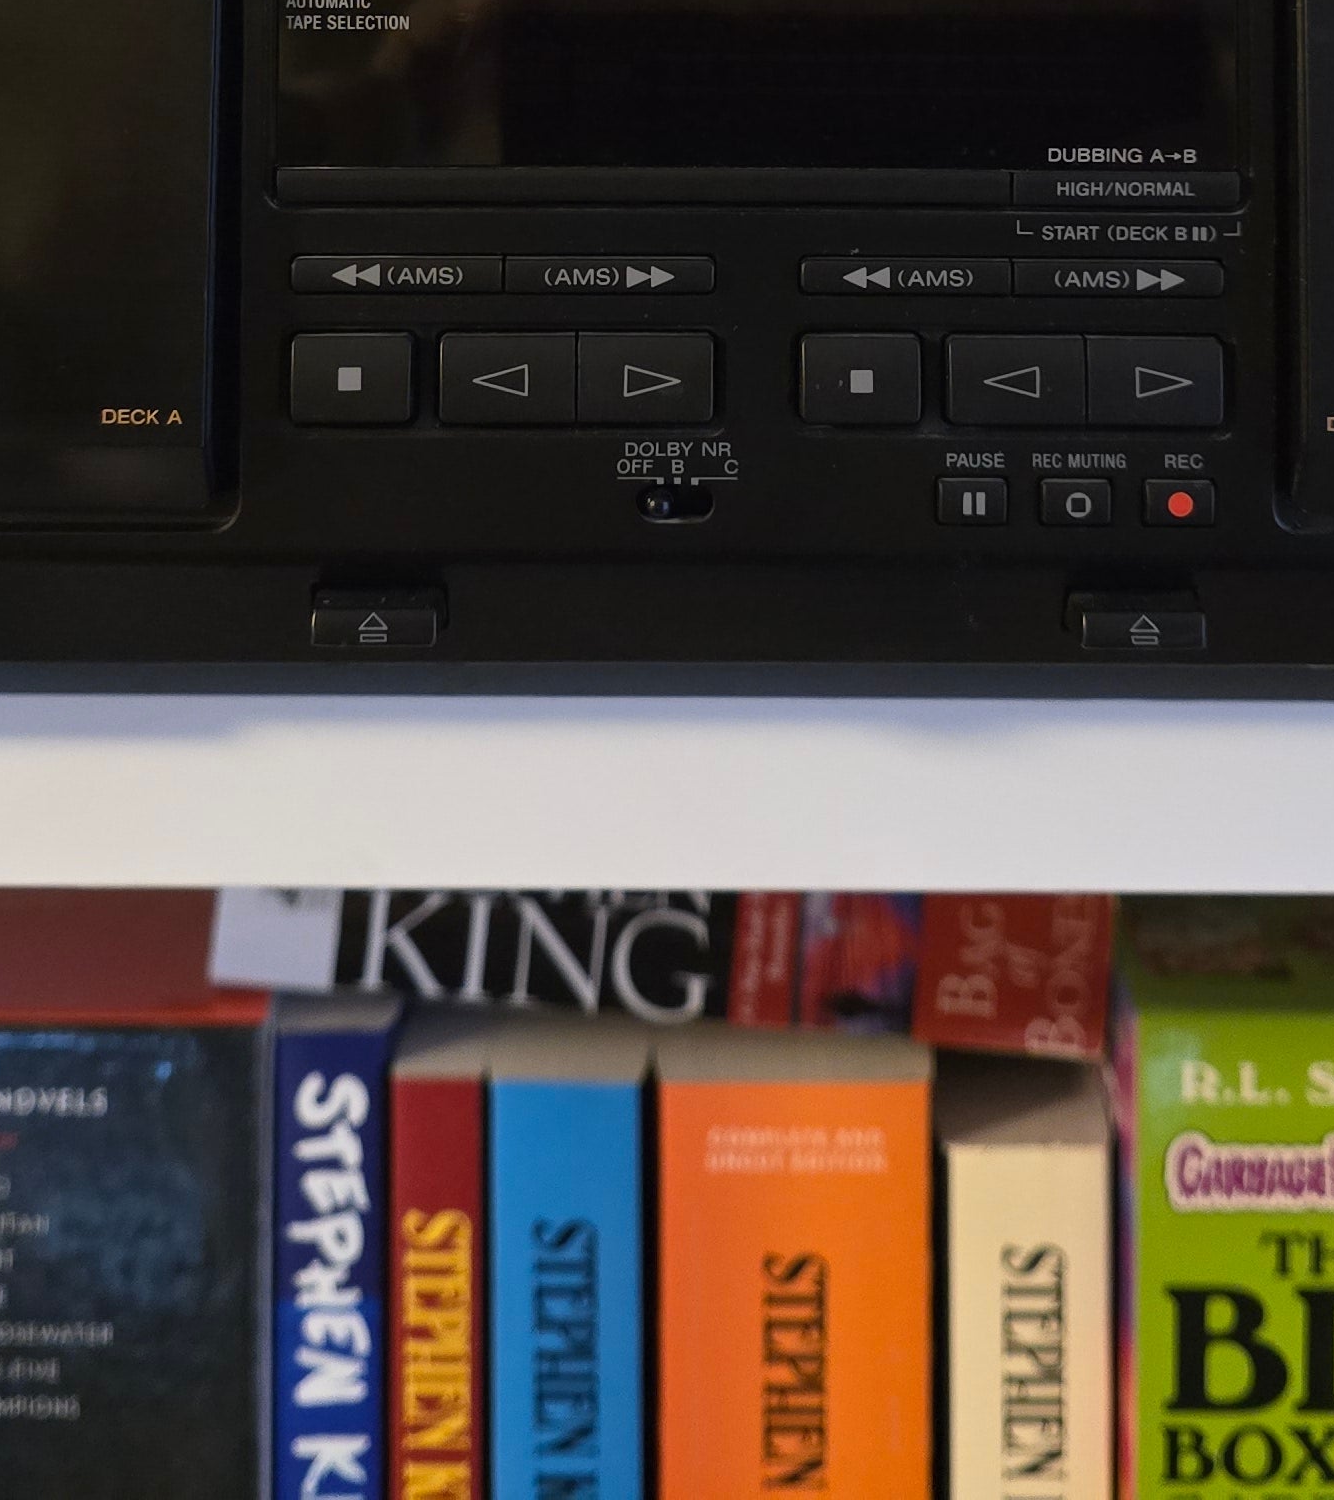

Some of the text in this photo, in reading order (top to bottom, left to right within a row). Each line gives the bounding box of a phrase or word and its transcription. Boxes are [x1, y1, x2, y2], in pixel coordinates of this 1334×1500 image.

[286, 16, 410, 31] TAPE SELECTION
[1047, 148, 1143, 164] DUBBING
[1056, 181, 1196, 198] HIGH/NORMAL
[1041, 226, 1100, 242] START
[386, 265, 464, 288] (AMS)
[543, 265, 621, 288] (AMS)
[896, 268, 974, 289] (AMS)
[1053, 269, 1131, 290] (AMS)
[101, 408, 183, 425] DECK A
[624, 441, 732, 457] DOLBY NR
[616, 459, 654, 474] OFF
[670, 460, 685, 474] B
[723, 460, 740, 474] C
[945, 452, 1006, 469] PAUSE
[1032, 453, 1127, 469] REC MUTING
[1164, 453, 1204, 470] REC
[360, 890, 710, 1024] KING
[1180, 1060, 1291, 1104] R.L.
[285, 1071, 370, 1407] STEPHEN
[401, 1208, 473, 1451] STEPHEN
[531, 1216, 601, 1457] STEPHEN
[1001, 1241, 1066, 1483] STEPHEN
[761, 1250, 830, 1492] STEPHEN
